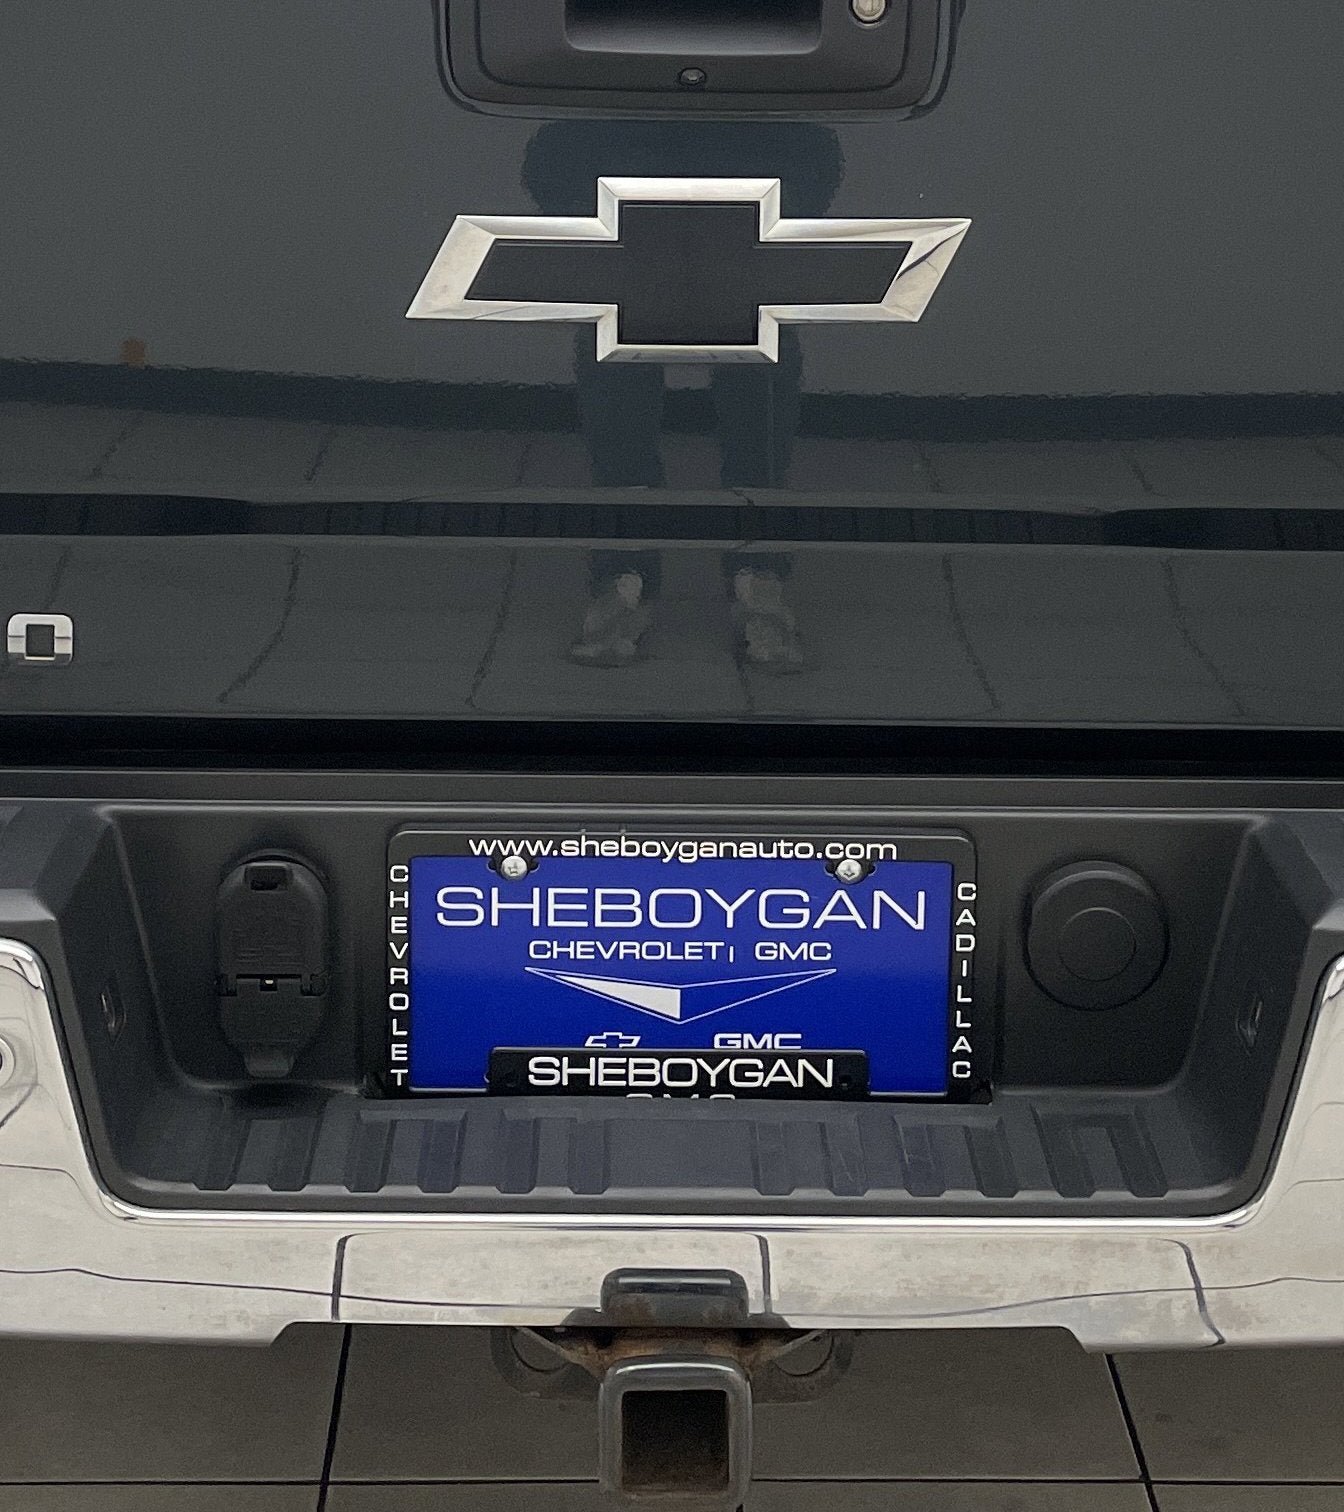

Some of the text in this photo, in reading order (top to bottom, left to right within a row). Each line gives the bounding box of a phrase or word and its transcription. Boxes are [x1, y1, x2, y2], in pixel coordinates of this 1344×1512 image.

[468, 835, 898, 863] www.sheboyganauto.com
[436, 886, 926, 931] SHEBOYGAN
[529, 940, 832, 961] CHEVROLET GMC
[388, 865, 410, 1086] CHEVROLET
[951, 882, 977, 1079] CADILLAC
[713, 1033, 802, 1049] GMC
[528, 1056, 834, 1088] SHEBOYGAN
